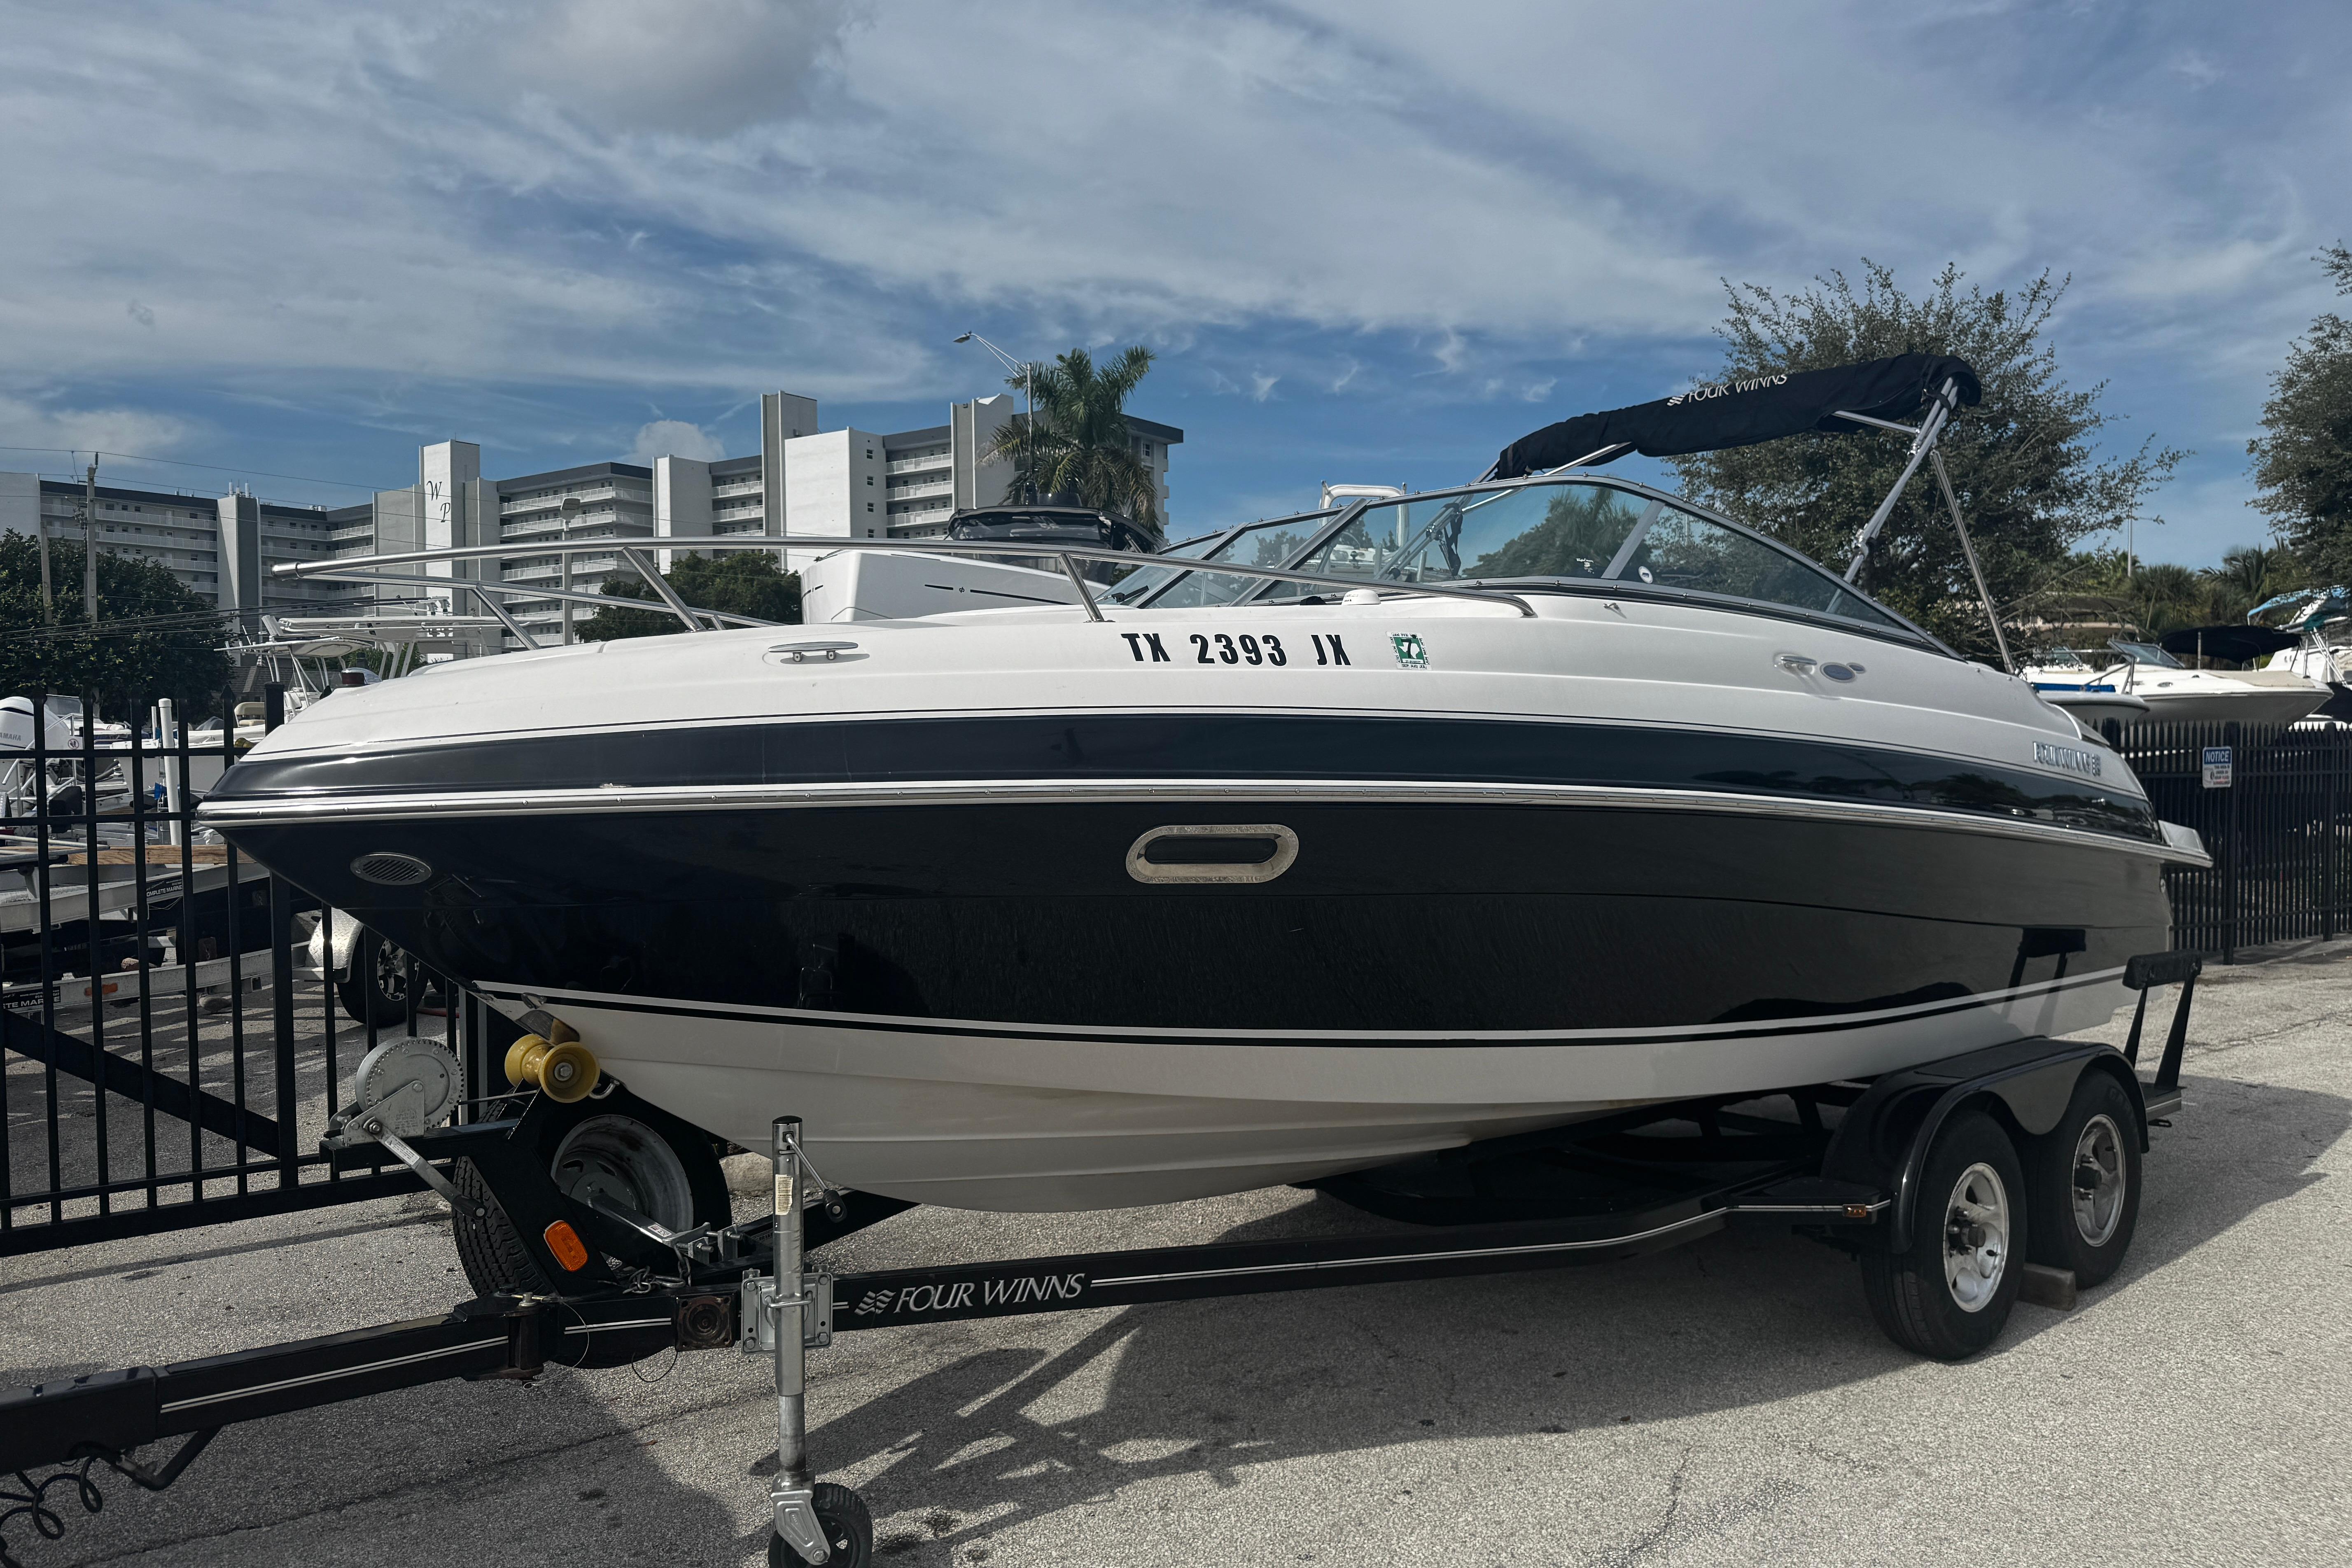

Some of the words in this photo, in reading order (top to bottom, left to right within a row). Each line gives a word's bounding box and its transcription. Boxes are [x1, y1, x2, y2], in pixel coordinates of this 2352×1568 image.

[1736, 374, 1787, 394] WINNS
[426, 481, 442, 501] W
[440, 502, 450, 523] P
[1121, 633, 1171, 662] TX
[1190, 634, 1287, 666] 2393
[1311, 635, 1351, 665] JX
[1400, 638, 1412, 659] 7
[0, 733, 21, 741] AMAHA
[2205, 751, 2230, 763] NOTICE
[146, 888, 166, 896] OMPLETE
[21, 996, 60, 1006] MARE
[894, 1282, 975, 1314] FOUR
[983, 1273, 1085, 1304] WINNS
